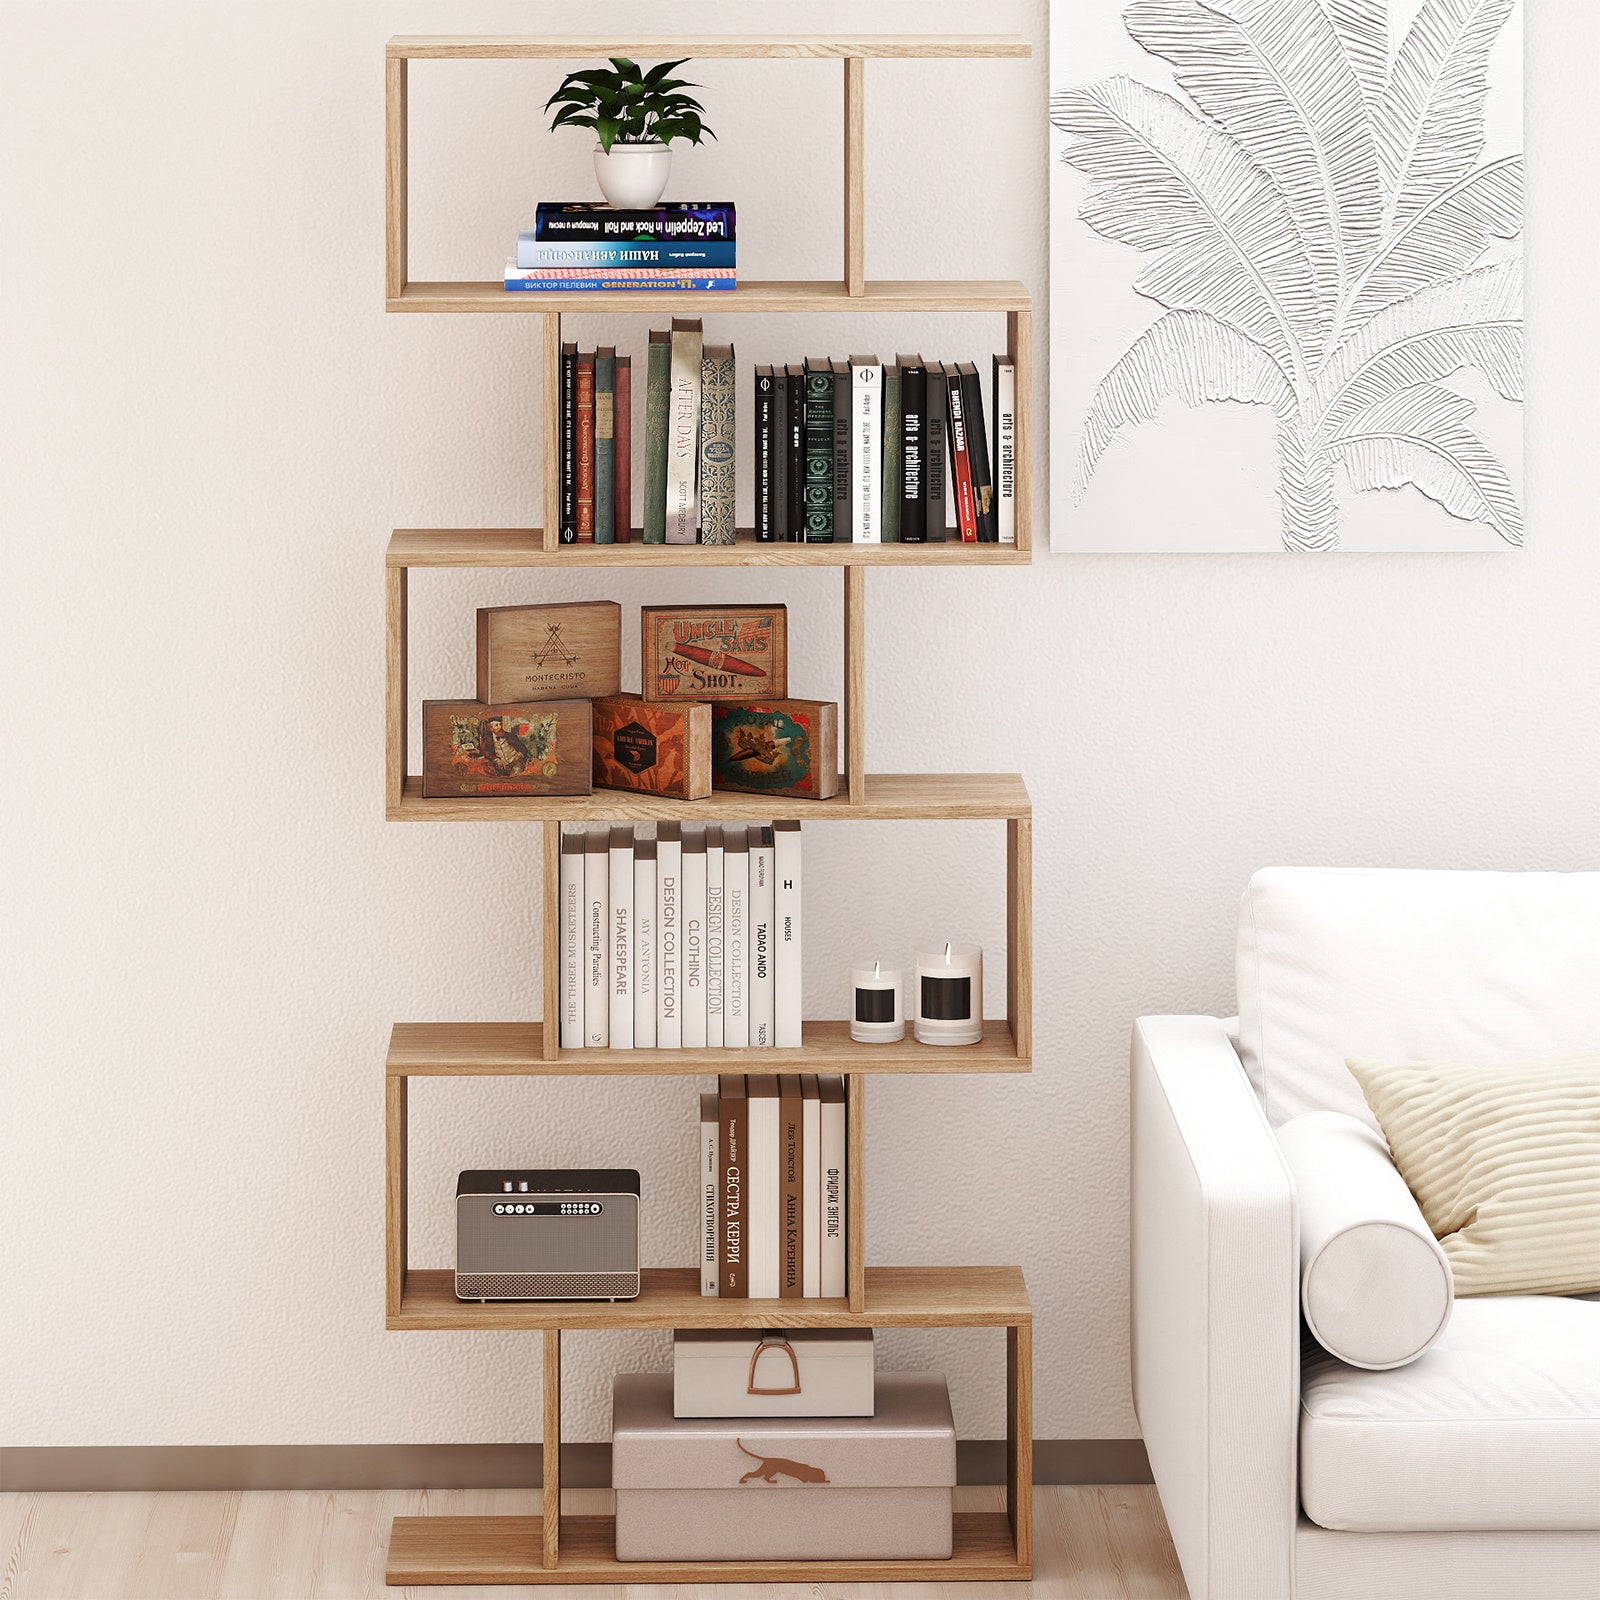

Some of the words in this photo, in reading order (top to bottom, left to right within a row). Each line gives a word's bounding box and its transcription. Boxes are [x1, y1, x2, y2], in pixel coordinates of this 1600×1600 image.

[604, 221, 619, 235] Roll
[621, 221, 634, 234] and
[636, 221, 654, 235] Rock
[655, 222, 662, 234] in
[665, 219, 705, 236] Zeppelin
[706, 221, 724, 236] Led
[537, 248, 617, 261] АВИАНОСЦЫ
[620, 251, 659, 261] НАШИ
[678, 378, 693, 420] AFTER
[951, 390, 960, 419] BHENDI
[836, 418, 849, 435] arts
[906, 414, 921, 431] arts
[930, 419, 943, 435] arts
[954, 421, 965, 451] BAZAAR
[1002, 413, 1013, 430] arts
[676, 425, 692, 458] DAYS
[836, 449, 850, 500] architecture
[906, 446, 921, 499] architecture
[930, 450, 943, 501] architecture
[1002, 445, 1014, 498] architecture
[679, 481, 687, 501] SCOTT
[677, 502, 686, 535] MEDBURY
[673, 619, 738, 644] UNCLE
[525, 672, 586, 682] MONTECRISTO
[663, 657, 691, 674] HOT
[689, 669, 742, 690] SHOT.
[663, 877, 675, 927] DESIGN
[708, 887, 722, 933] DESIGN
[731, 890, 741, 936] DESIGN
[568, 883, 576, 958] MUSKETEERS
[590, 901, 602, 951] Constructing
[642, 918, 650, 935] MY
[616, 908, 627, 995] SHAKESPEARE
[688, 919, 700, 987] CLOTHING
[757, 923, 767, 952] TADAO
[568, 962, 576, 999] THREE
[592, 953, 602, 986] Paradies
[642, 940, 650, 994] ANTONIA
[663, 931, 675, 1018] COLLECTION
[708, 937, 722, 1015] COLLECTION
[731, 940, 741, 1016] COLLECTION
[757, 954, 767, 978] ANDO
[568, 1002, 576, 1024] THE
[727, 1166, 740, 1217] СЕСТРА
[827, 1168, 840, 1203] ФРИДРИХ
[706, 1184, 715, 1261] СТИХОТВОРЕНИЯ
[787, 1193, 797, 1226] АННА
[828, 1206, 839, 1237] ЭНГЕЛЬС
[727, 1221, 740, 1263] КЕРРИ
[787, 1229, 797, 1287] КАРЕНИНА
